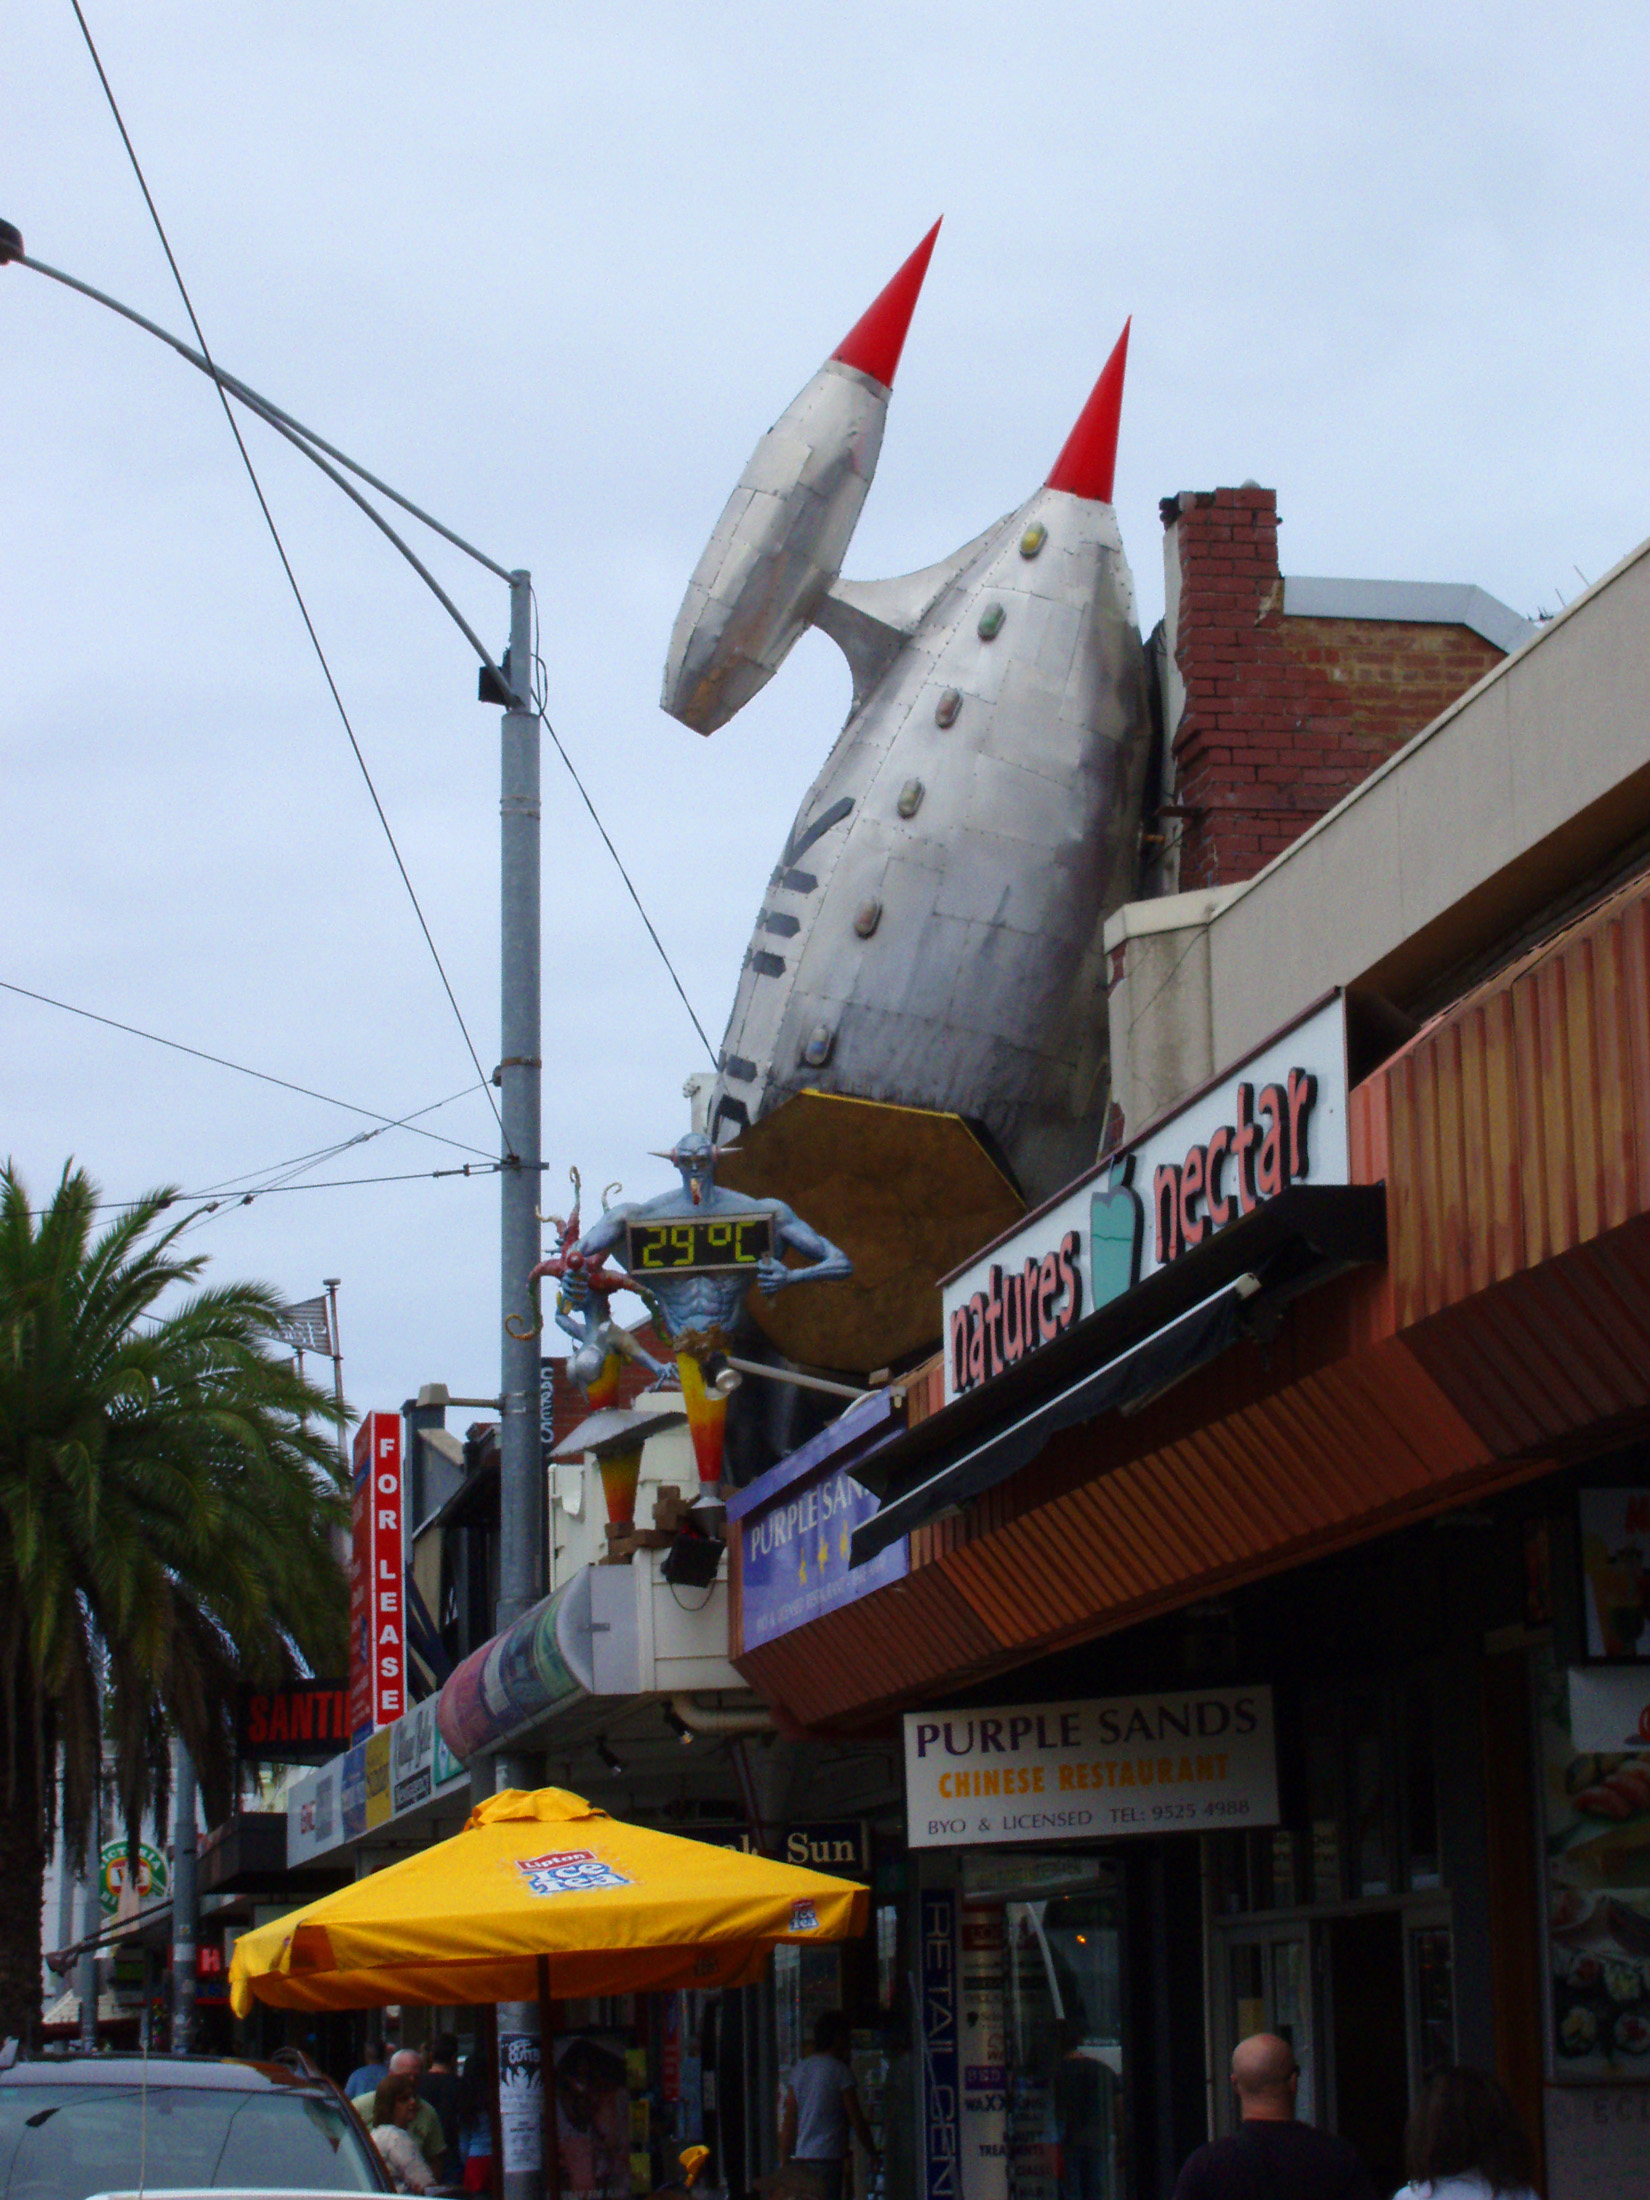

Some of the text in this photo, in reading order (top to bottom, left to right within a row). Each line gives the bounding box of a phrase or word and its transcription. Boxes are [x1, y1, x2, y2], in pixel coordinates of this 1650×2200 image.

[950, 1066, 1318, 1393] natures nectar
[751, 1474, 870, 1562] PURPLE SAN
[378, 1438, 400, 1710] FOR LEASE
[917, 1697, 1258, 1758] PURPLE SANDS
[939, 1753, 1229, 1798] CHINESE RESTAURANT
[928, 1819, 967, 1835] BYO
[978, 1817, 991, 1832] &
[1003, 1811, 1093, 1831] LICENSED
[1152, 1803, 1196, 1821] 9525
[1203, 1799, 1250, 1817] 4988
[523, 1852, 586, 1869] Lipton
[787, 1832, 857, 1864] Sun
